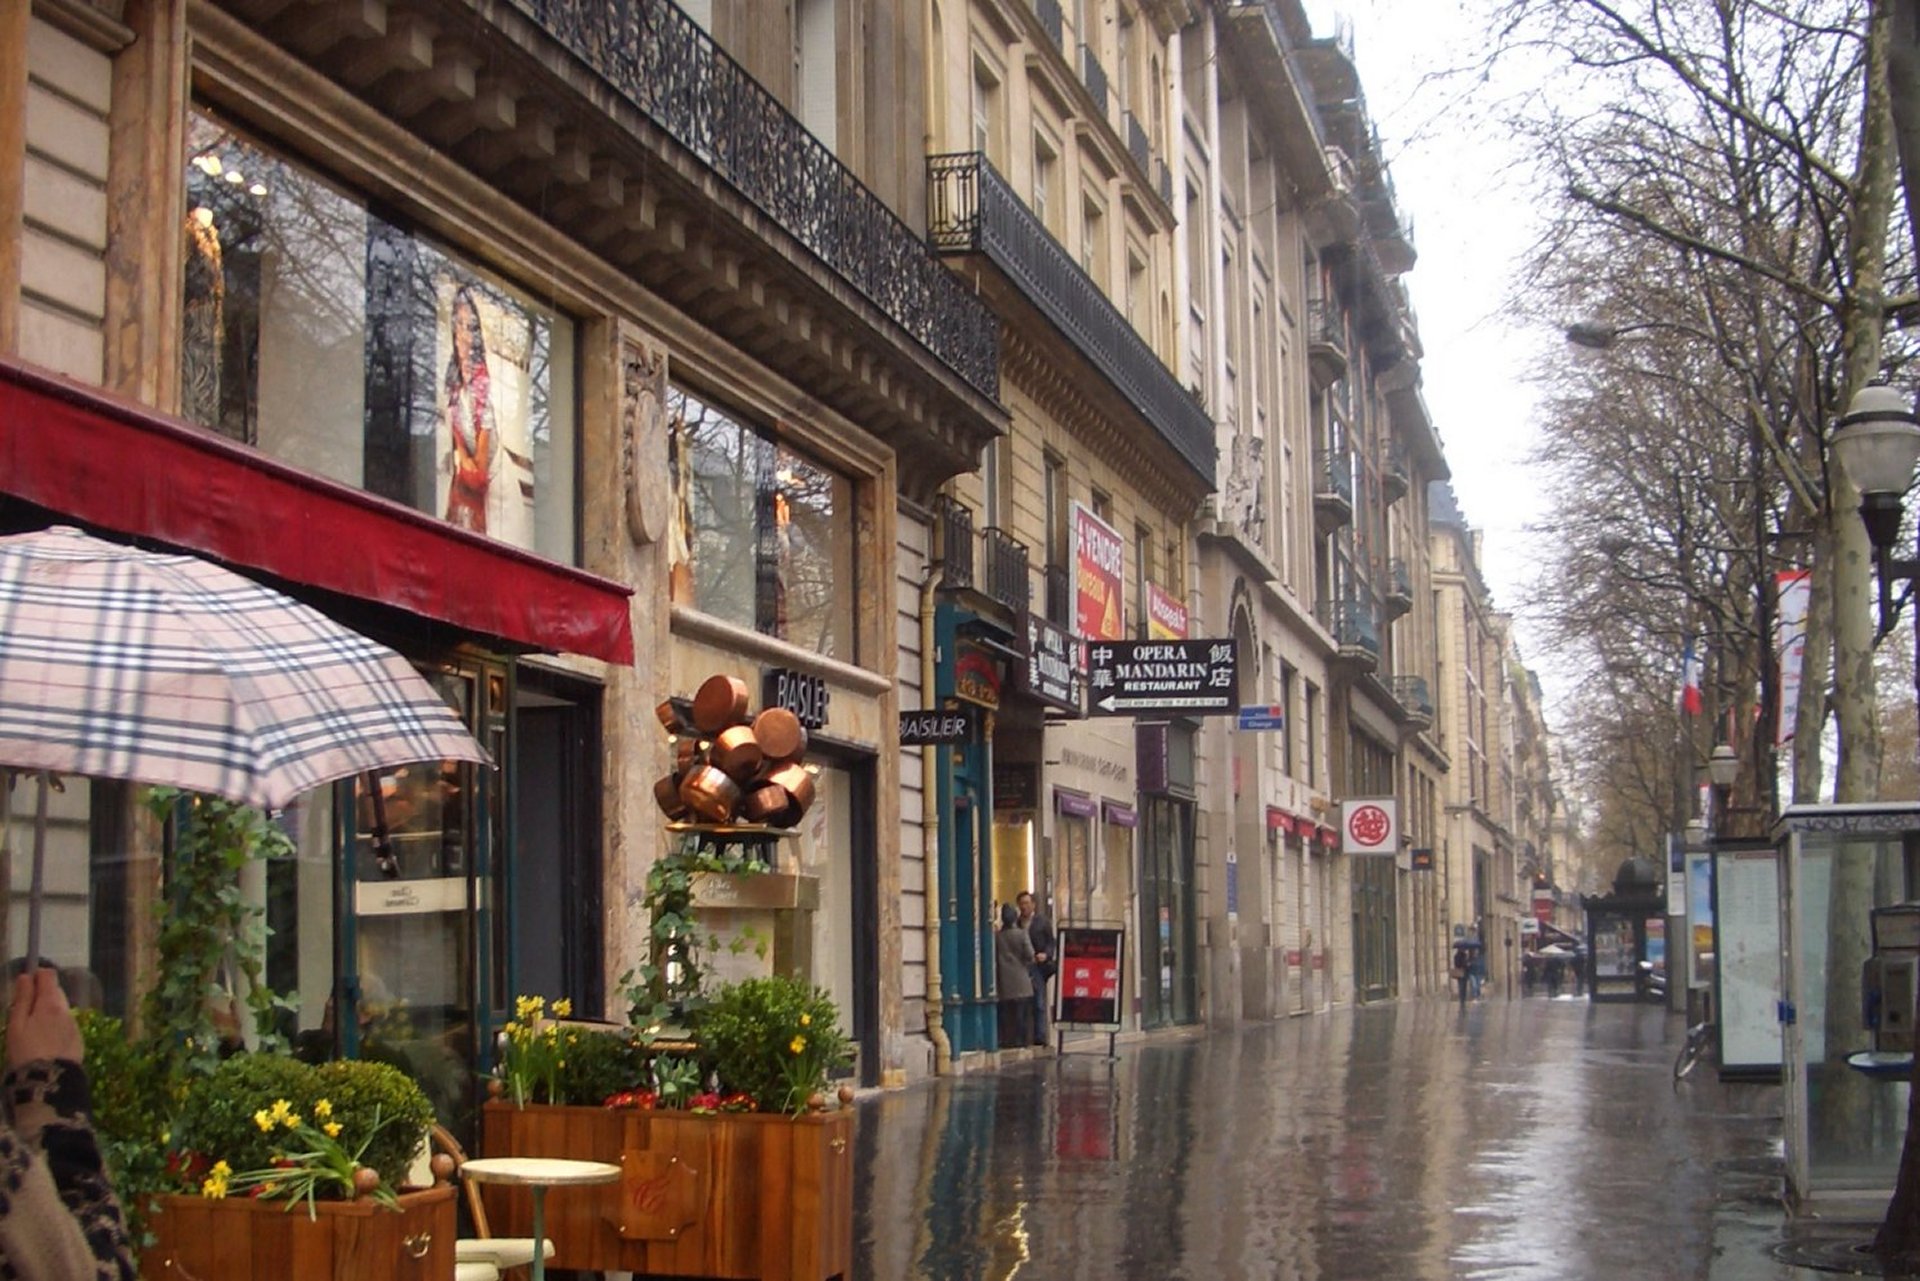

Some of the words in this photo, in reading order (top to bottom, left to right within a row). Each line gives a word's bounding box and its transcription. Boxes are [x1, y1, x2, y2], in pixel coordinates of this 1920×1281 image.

[1085, 523, 1121, 580] VENDRE
[1133, 645, 1187, 660] OPERA
[1209, 644, 1234, 687] 飯店
[1092, 646, 1115, 689] 中華
[1116, 663, 1207, 678] MANDARIN
[1124, 681, 1200, 691] RESTAURANT
